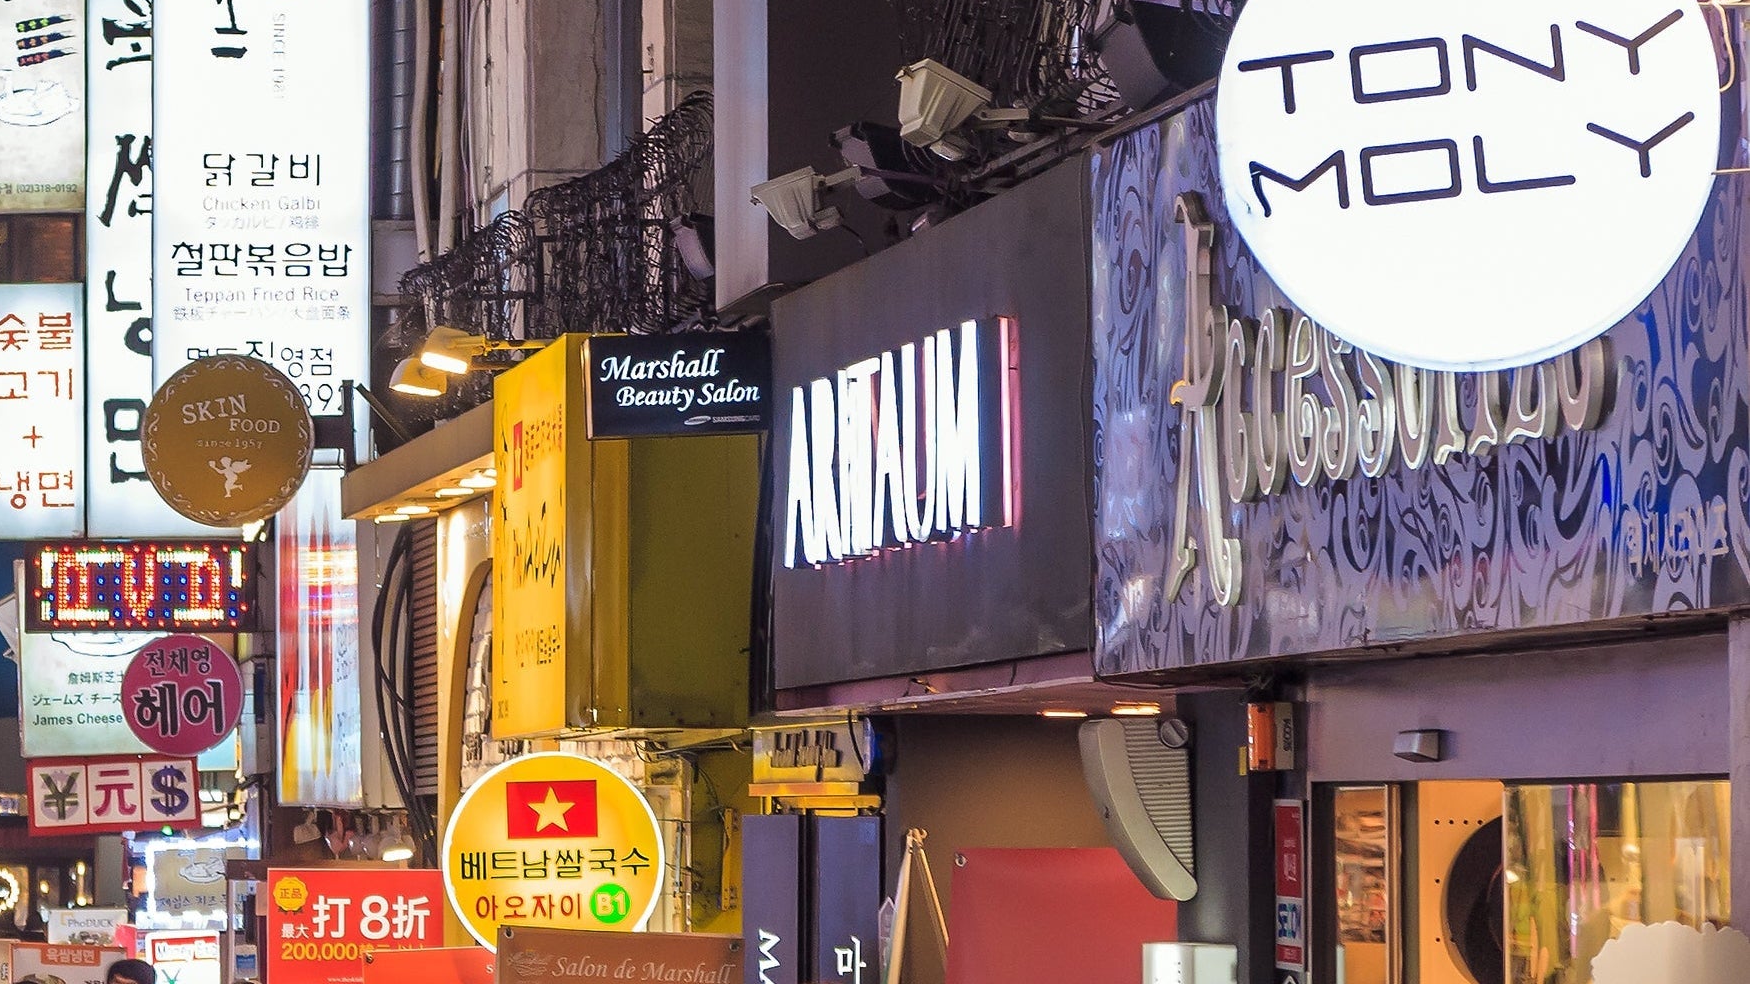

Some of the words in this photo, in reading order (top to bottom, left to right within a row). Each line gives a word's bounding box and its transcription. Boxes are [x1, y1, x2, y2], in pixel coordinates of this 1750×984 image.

[1237, 8, 1684, 115] TONY
[203, 153, 321, 187] 닭갈비
[1247, 111, 1695, 218] MOLY
[16, 183, 78, 194] (02)318-0192
[202, 196, 271, 212] Chicken
[278, 196, 322, 212] Galbi
[171, 241, 353, 278] 철판볶음밥
[185, 287, 247, 304] Teppan
[252, 287, 296, 303] Fried
[302, 287, 340, 303] Rice
[600, 348, 726, 382] Marshall
[182, 393, 248, 425] SKIN
[616, 384, 695, 412] Beauty
[696, 378, 761, 406] Salon
[229, 417, 281, 434] FOOD
[144, 645, 212, 678] 전채영
[32, 713, 74, 726] James
[77, 713, 123, 725] Cheese
[133, 679, 228, 739] 헤어
[93, 768, 138, 817] 元
[151, 764, 190, 818] $
[460, 848, 651, 881] 베트남쌀국수
[475, 892, 583, 921] 아오자이
[596, 890, 628, 917] B1
[551, 956, 608, 979] Salon
[613, 961, 636, 979] de
[639, 962, 736, 984] Marshall
